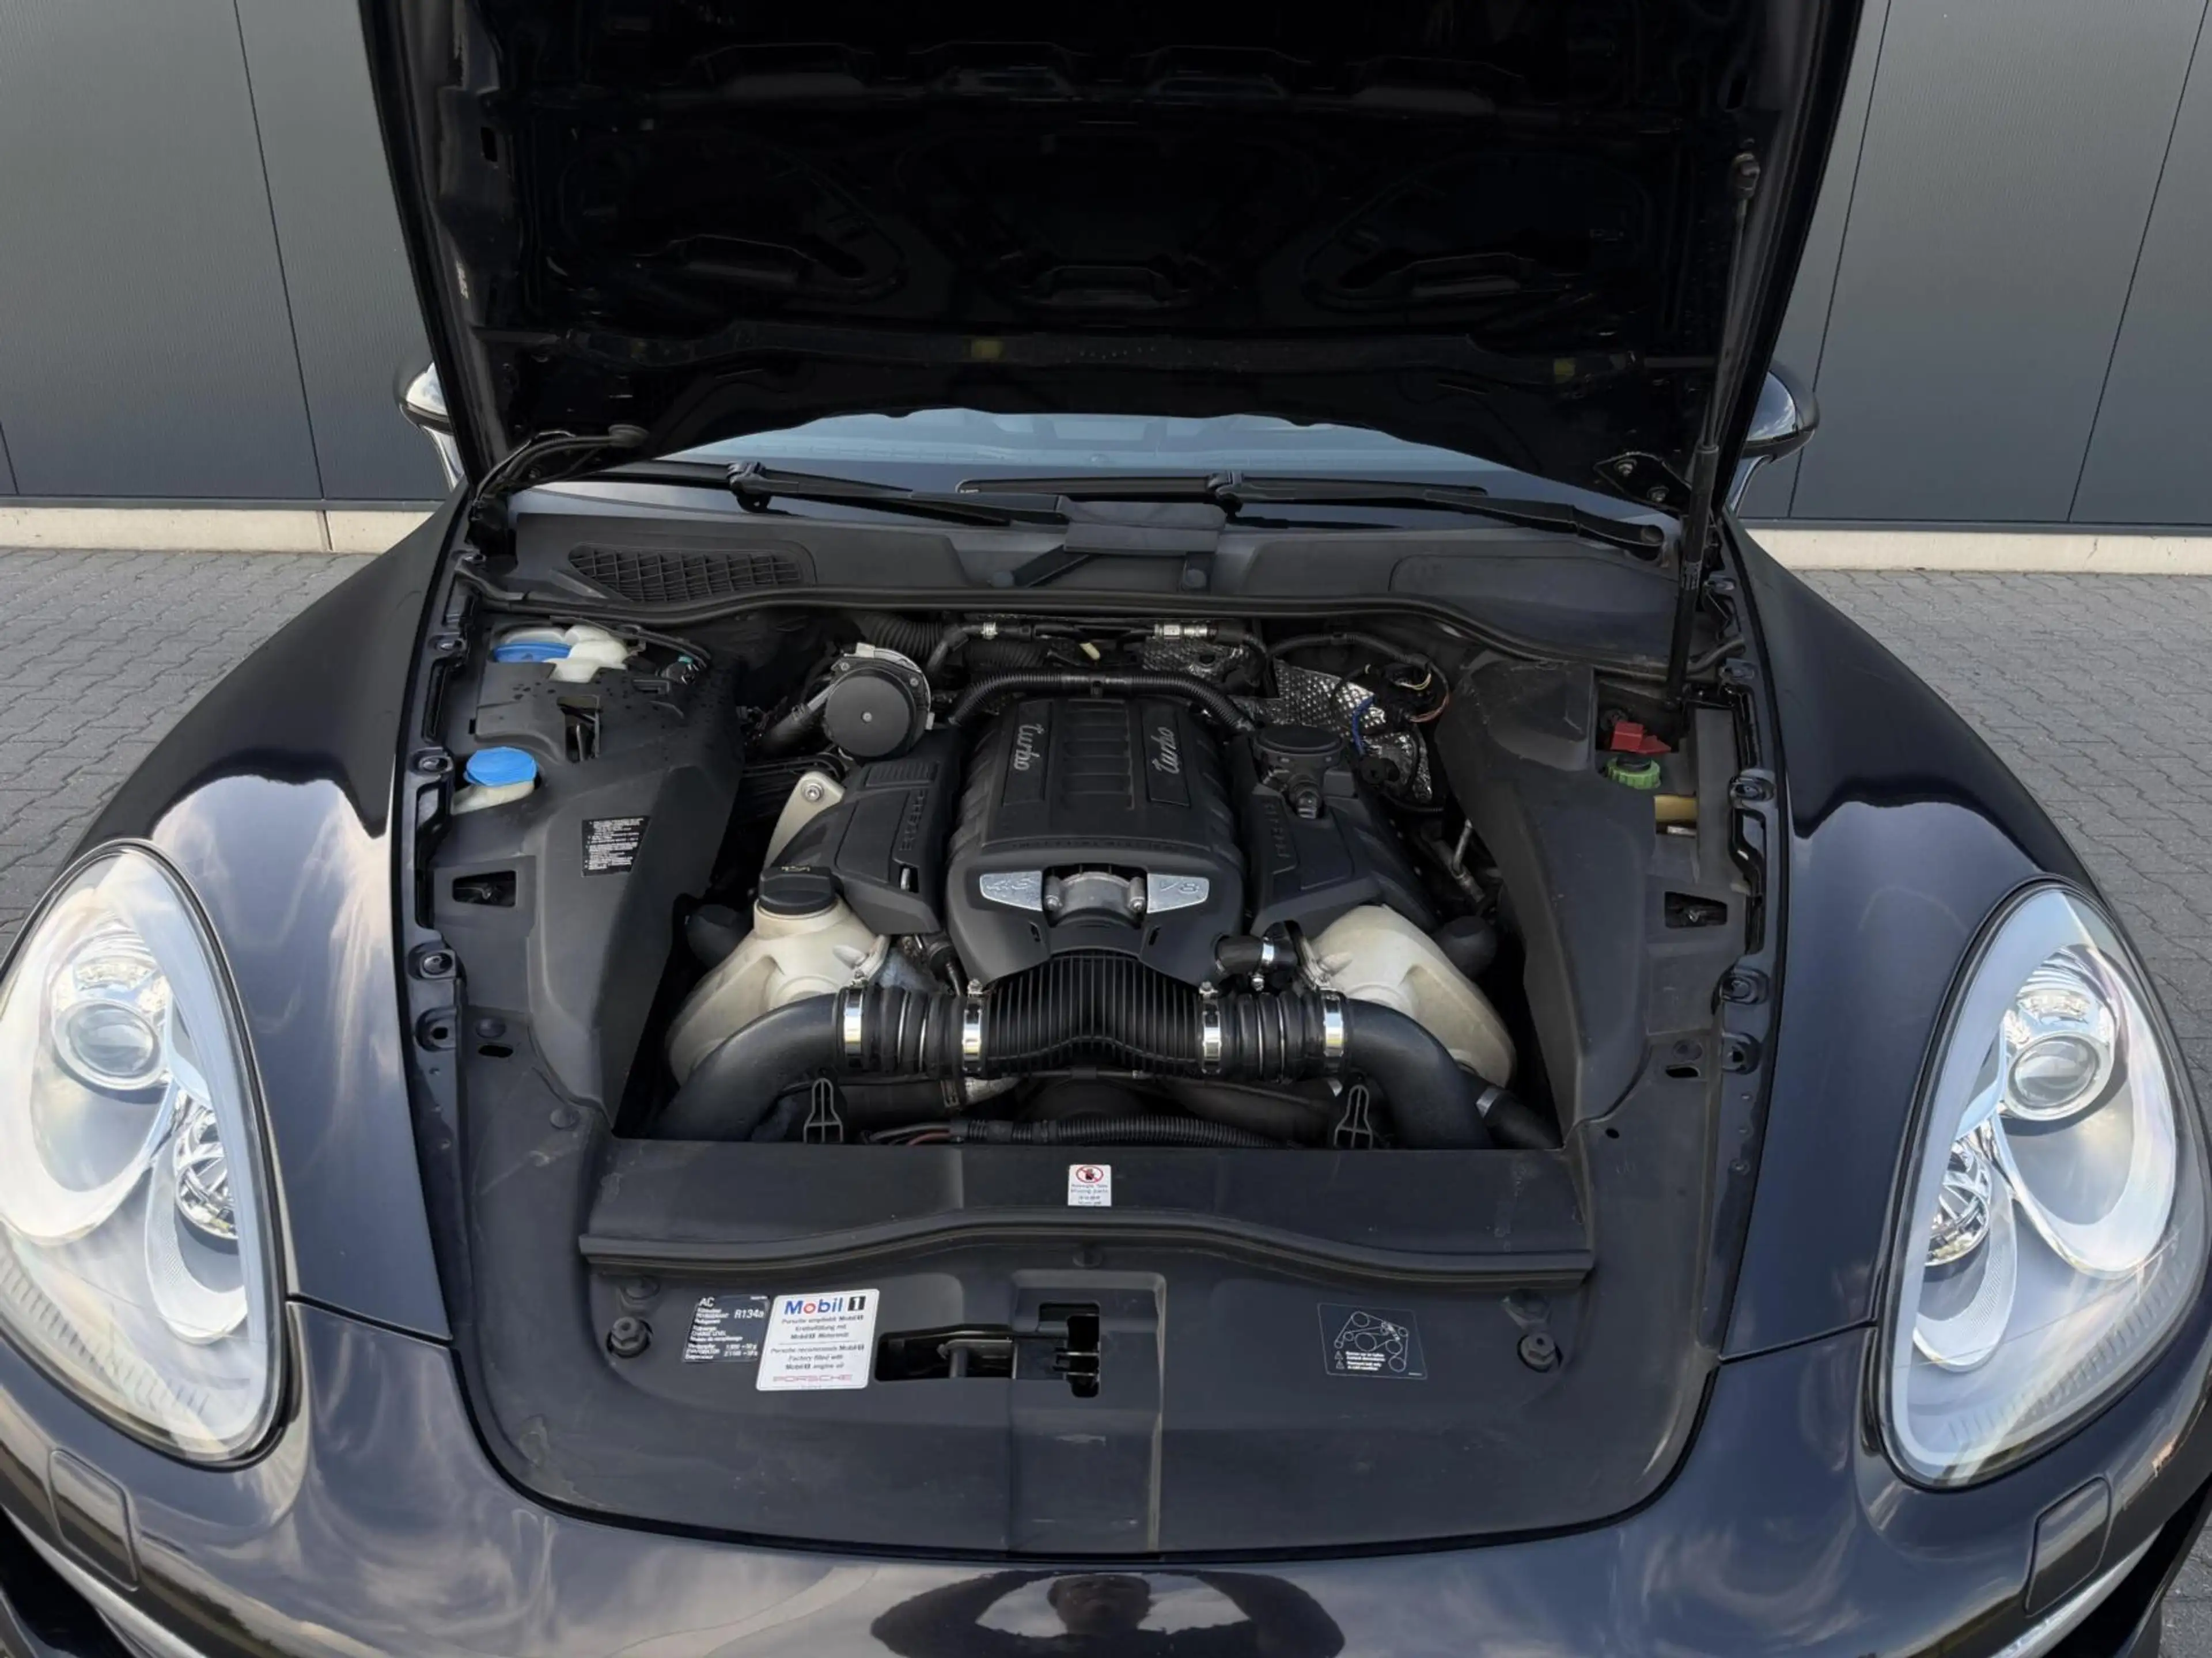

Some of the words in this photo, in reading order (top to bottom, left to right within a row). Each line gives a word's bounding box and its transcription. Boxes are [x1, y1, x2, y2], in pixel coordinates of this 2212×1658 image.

[699, 1297, 714, 1307] AC
[784, 1297, 843, 1314] Mobil
[734, 1309, 764, 1319] R134a
